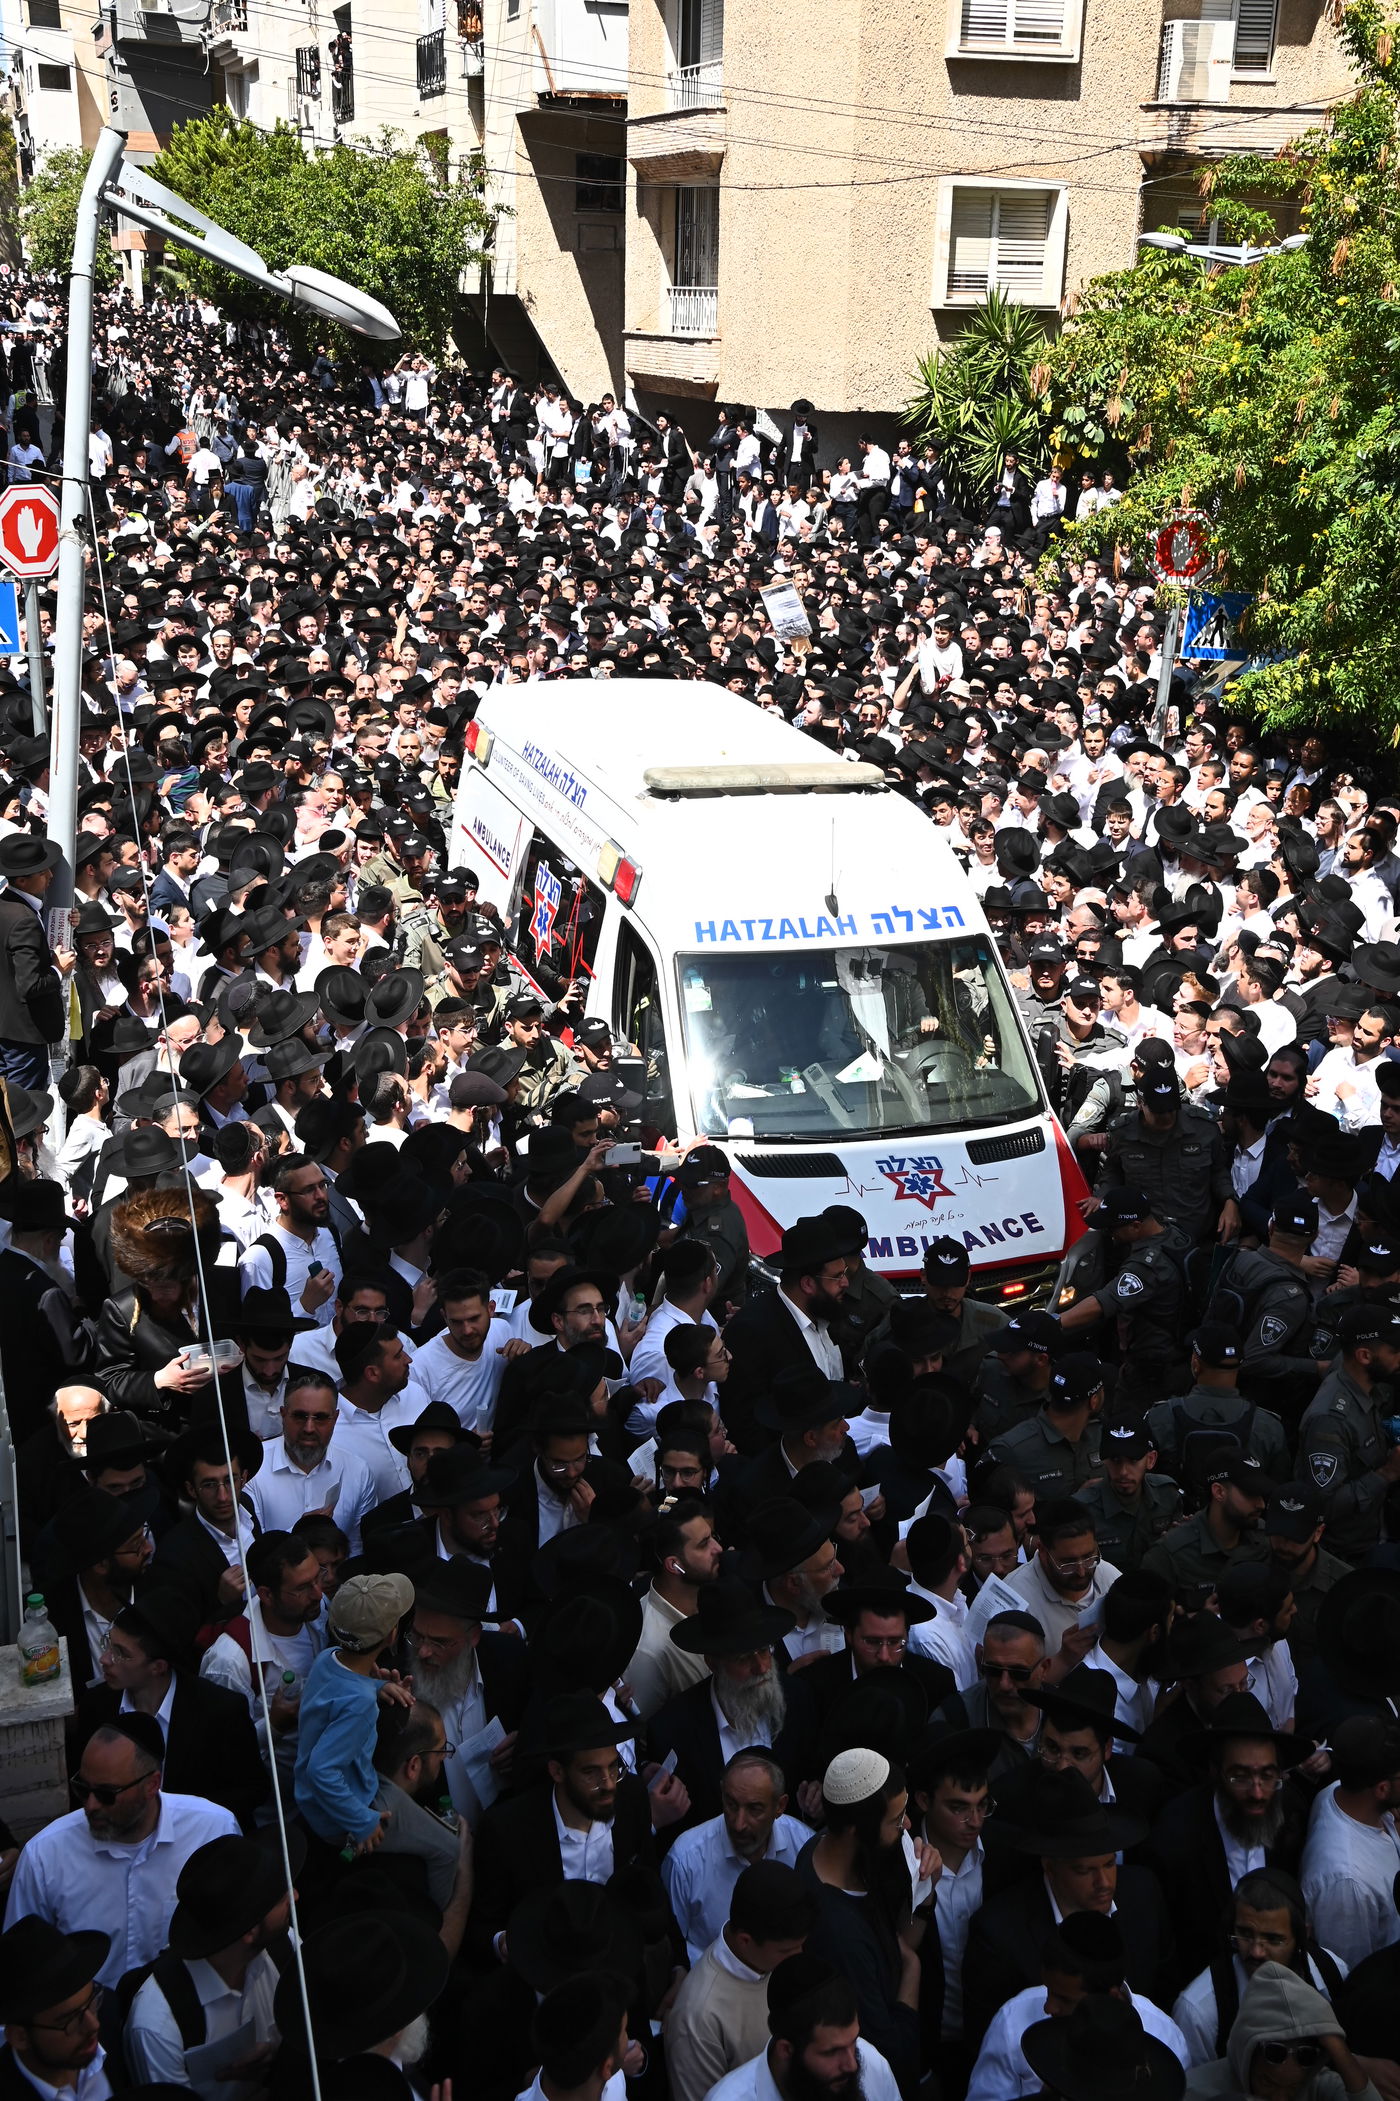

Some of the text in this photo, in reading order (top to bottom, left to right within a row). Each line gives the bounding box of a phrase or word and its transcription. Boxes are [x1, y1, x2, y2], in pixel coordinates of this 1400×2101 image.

[522, 740, 588, 808] HATZALAH הצלה
[473, 816, 511, 868] AMBULANCE
[536, 864, 561, 907] הצלה
[694, 905, 965, 943] HATZALAH הצלה
[592, 1096, 612, 1105] POLICE
[875, 1155, 944, 1174] הצלה
[930, 1213, 945, 1226] שניה
[947, 1209, 955, 1221] כל
[903, 1219, 928, 1231] קובעת
[1356, 1331, 1380, 1340] POLICE
[1207, 1472, 1230, 1482] POLICE
